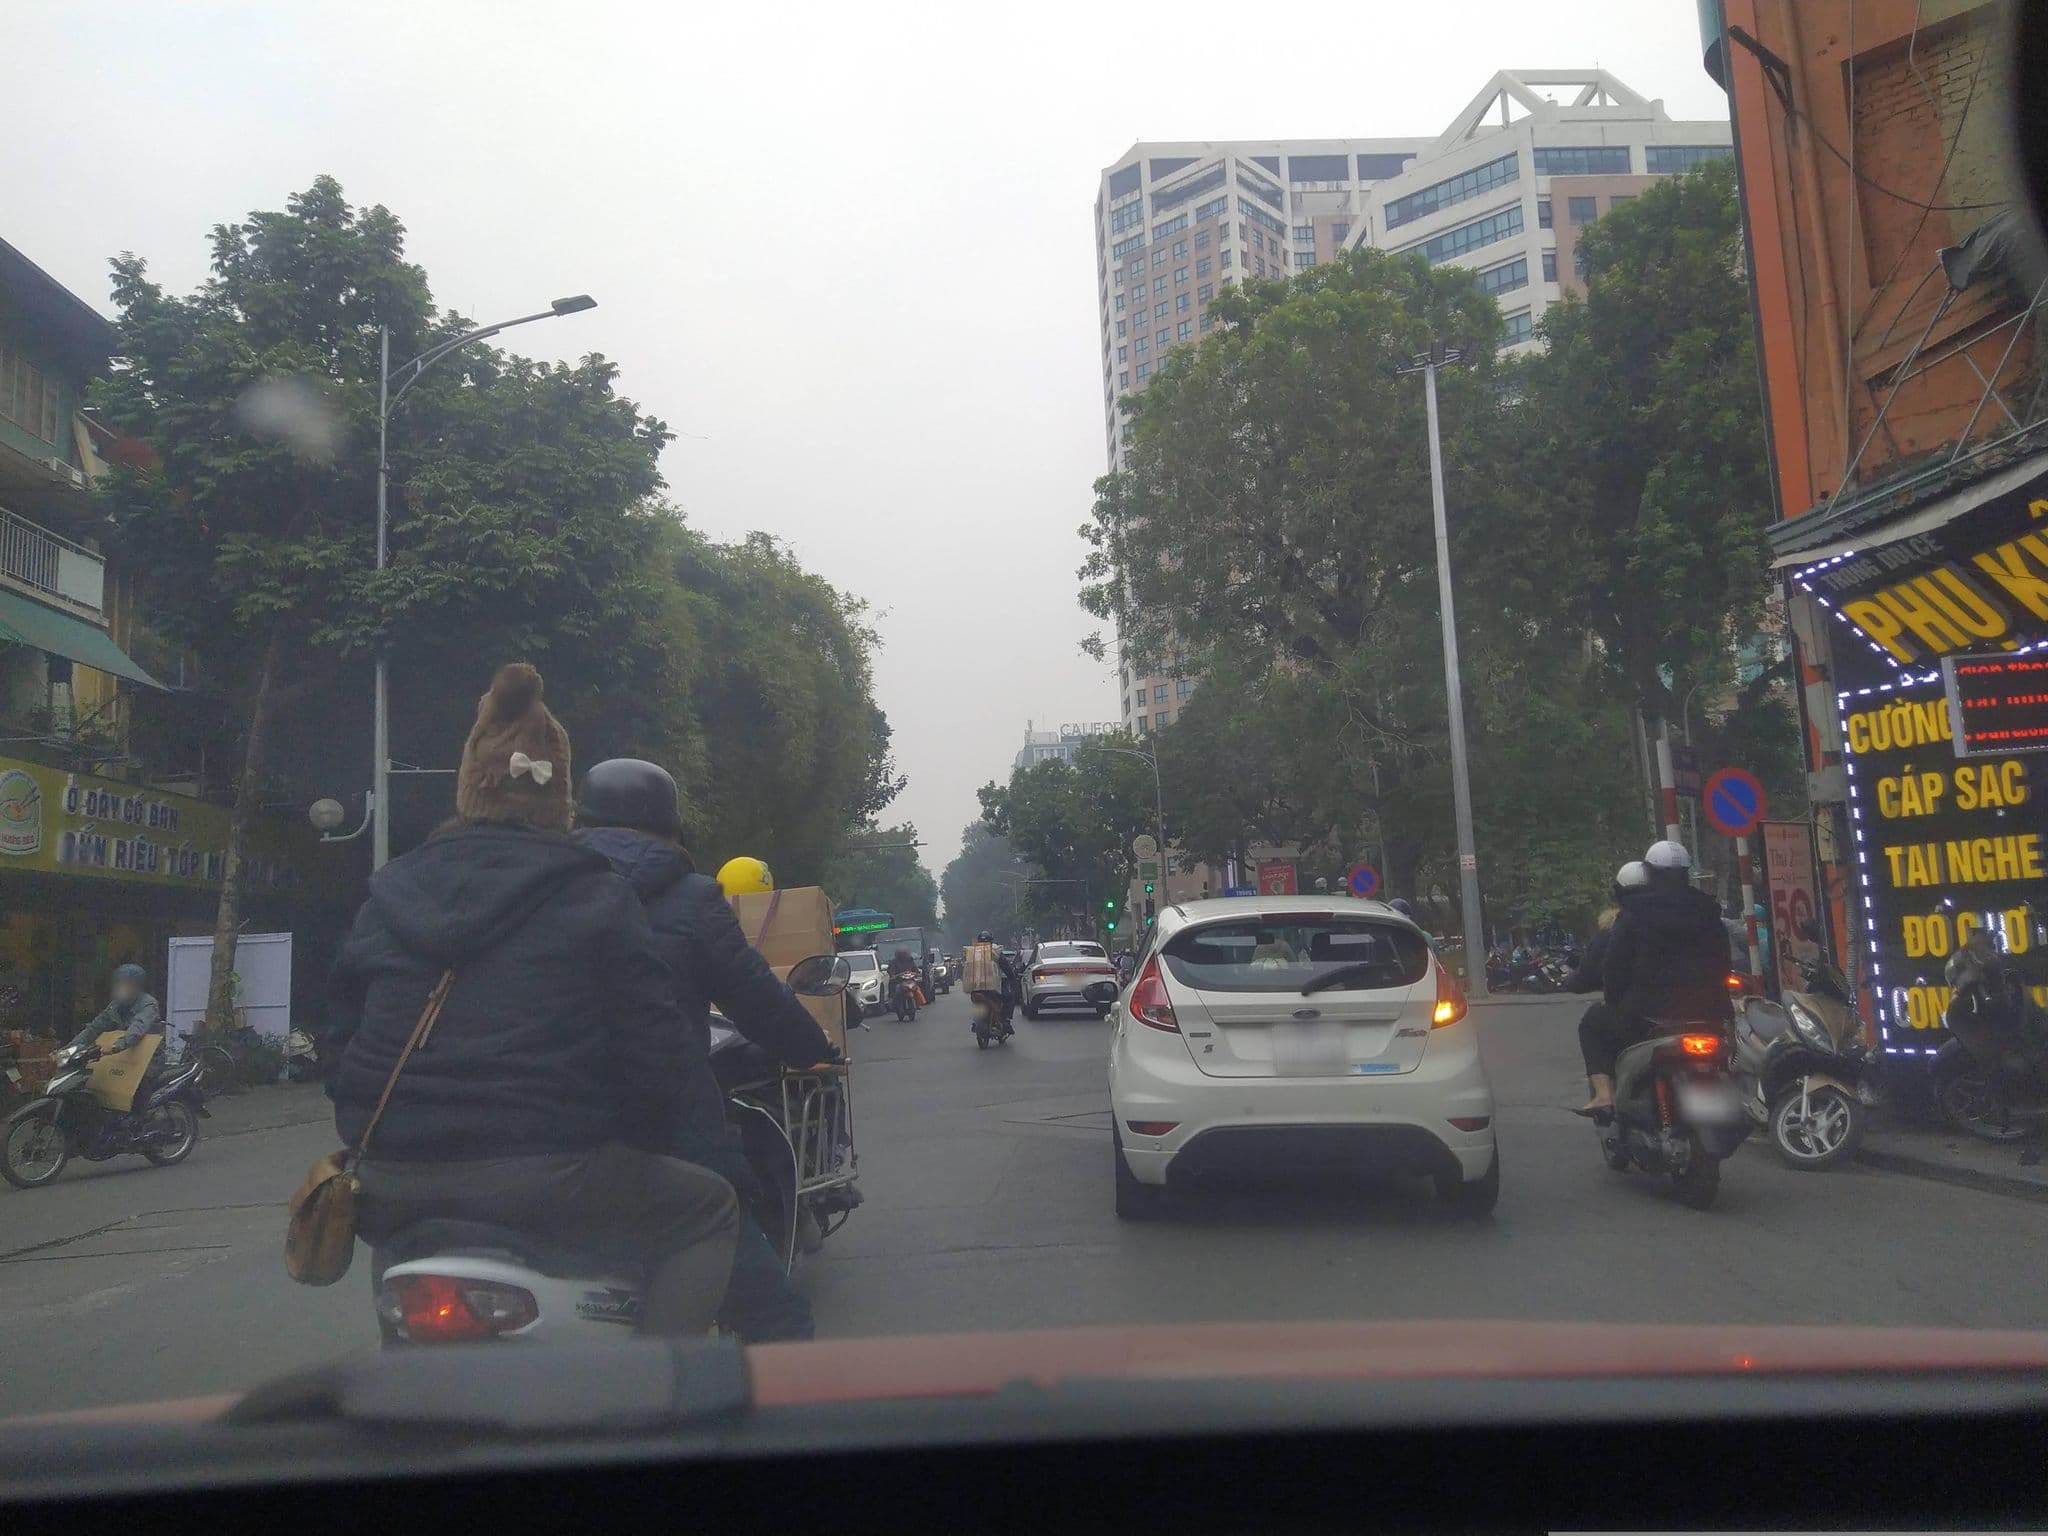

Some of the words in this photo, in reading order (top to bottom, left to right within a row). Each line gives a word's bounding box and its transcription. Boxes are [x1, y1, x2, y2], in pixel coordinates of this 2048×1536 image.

[1876, 763, 1944, 819] CÁP
[1884, 842, 1940, 888] TAI
[1945, 833, 2044, 884] NGHE
